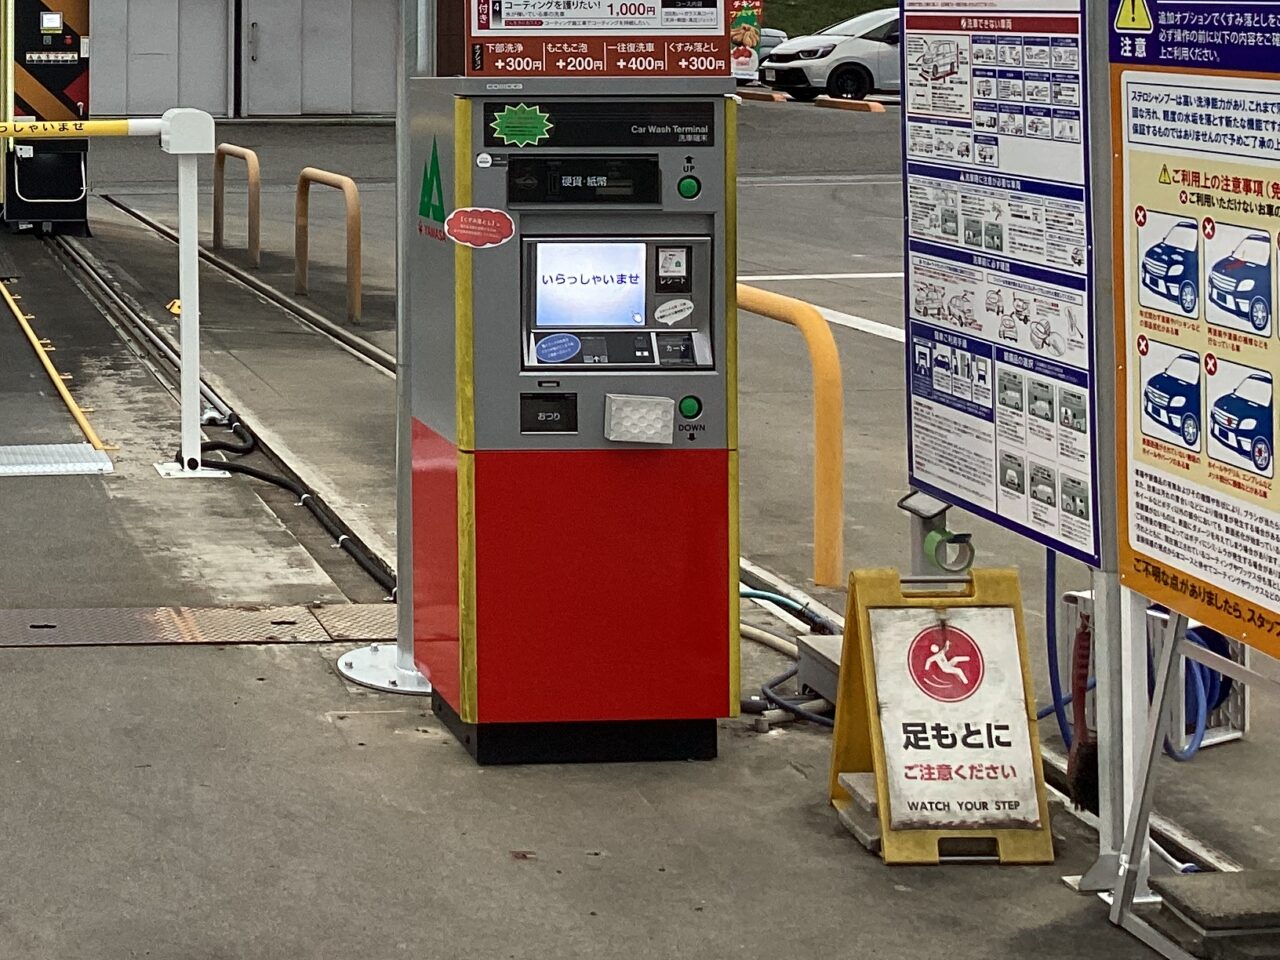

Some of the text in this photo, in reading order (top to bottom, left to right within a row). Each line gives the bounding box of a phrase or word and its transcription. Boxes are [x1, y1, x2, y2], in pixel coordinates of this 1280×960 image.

[504, 0, 601, 10] コーティングを護りたい!
[607, 2, 656, 16] 1,000円
[966, 18, 1012, 29] 洗車できない車両
[485, 43, 524, 54] 下部洗浄
[547, 43, 588, 54] もこもこ泡
[607, 43, 655, 54] 一往復洗車
[669, 43, 719, 53] くすみ落とし
[1120, 37, 1147, 58] 注意
[1158, 48, 1221, 62] 上ご利用ください。
[495, 57, 542, 71] +300円
[556, 57, 603, 71] +200円
[617, 57, 664, 71] +400円
[678, 57, 725, 71] +300円
[631, 125, 709, 134] Car Wash Terminal
[562, 176, 608, 187] 硬貨・紙幣
[542, 273, 640, 286] いらっしゃいませ
[537, 412, 561, 421] おつり
[678, 424, 706, 432] DOWN
[902, 722, 1012, 751] 足もとに
[903, 763, 1017, 782] ご注意ください
[907, 800, 1020, 812] WATCH YOUR STEP
